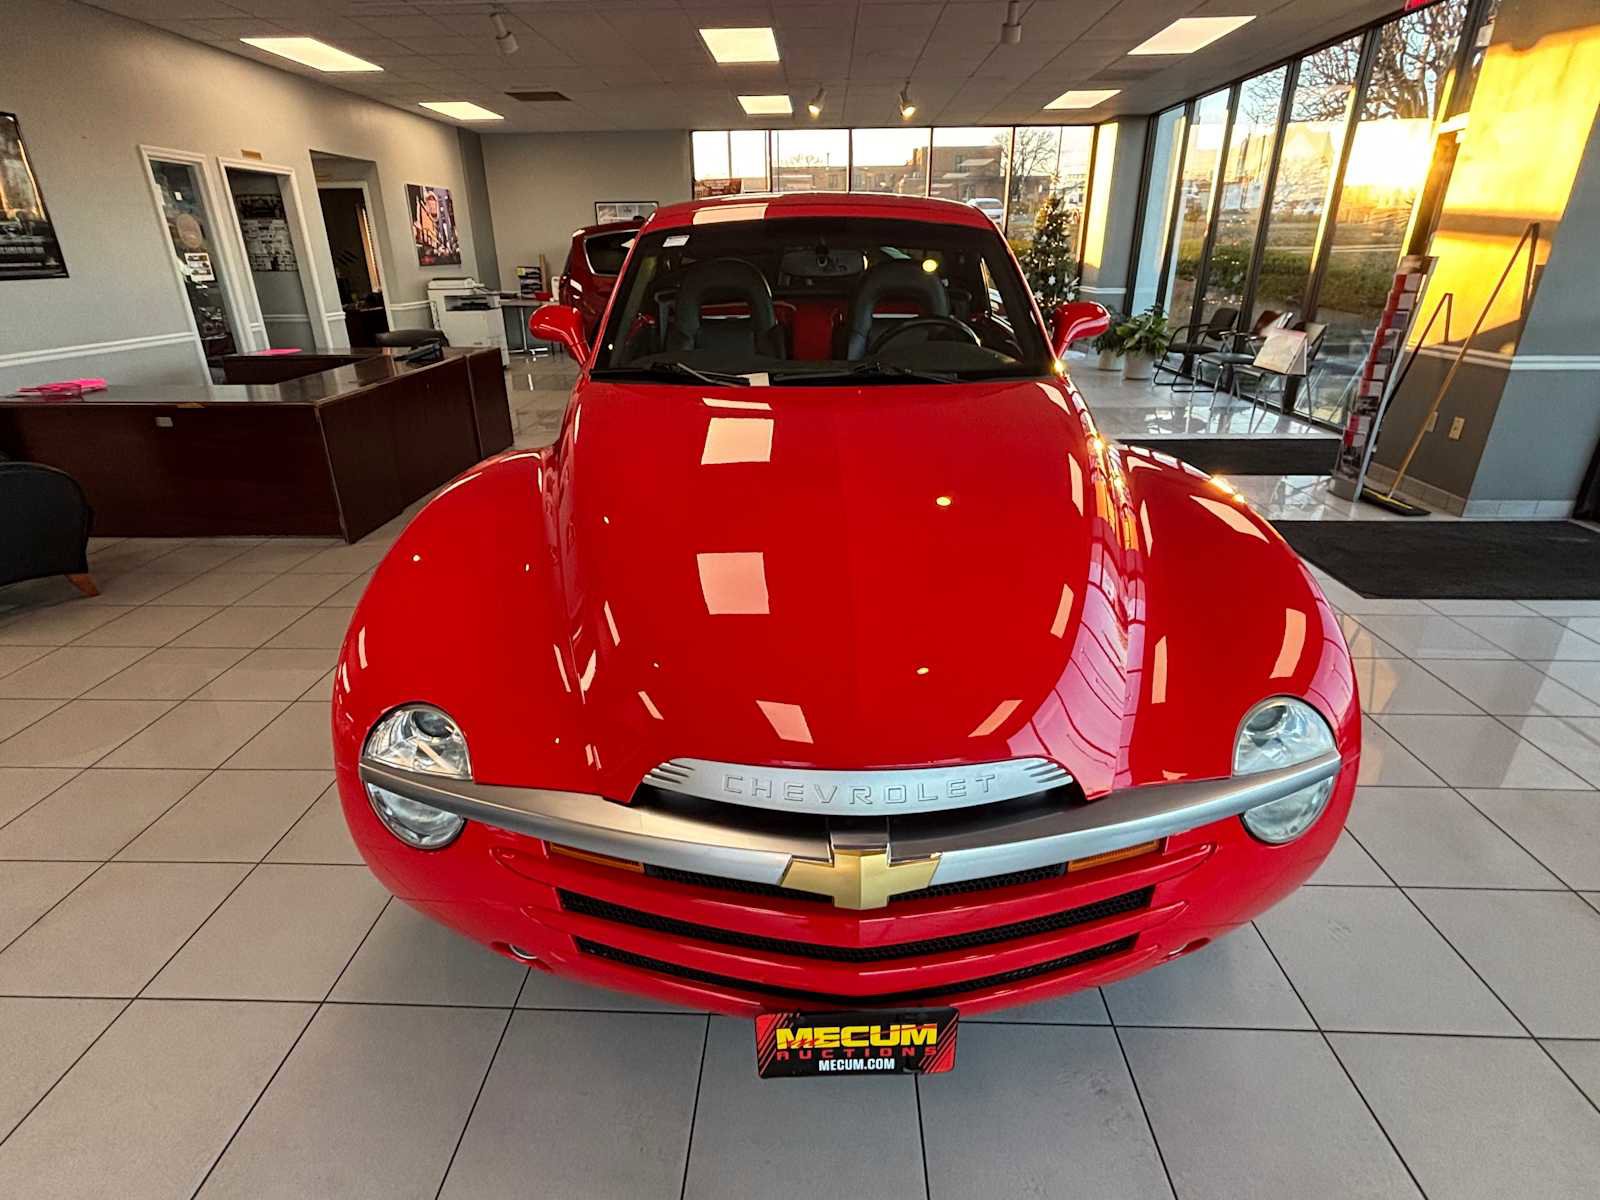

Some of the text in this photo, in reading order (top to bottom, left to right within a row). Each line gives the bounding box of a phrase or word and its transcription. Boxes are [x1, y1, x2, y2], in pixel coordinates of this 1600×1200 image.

[722, 772, 996, 805] CHEVROLET
[776, 1023, 938, 1050] MECUM
[776, 1046, 937, 1062] AUCTIONS
[818, 1058, 895, 1072] MECUM.COM
